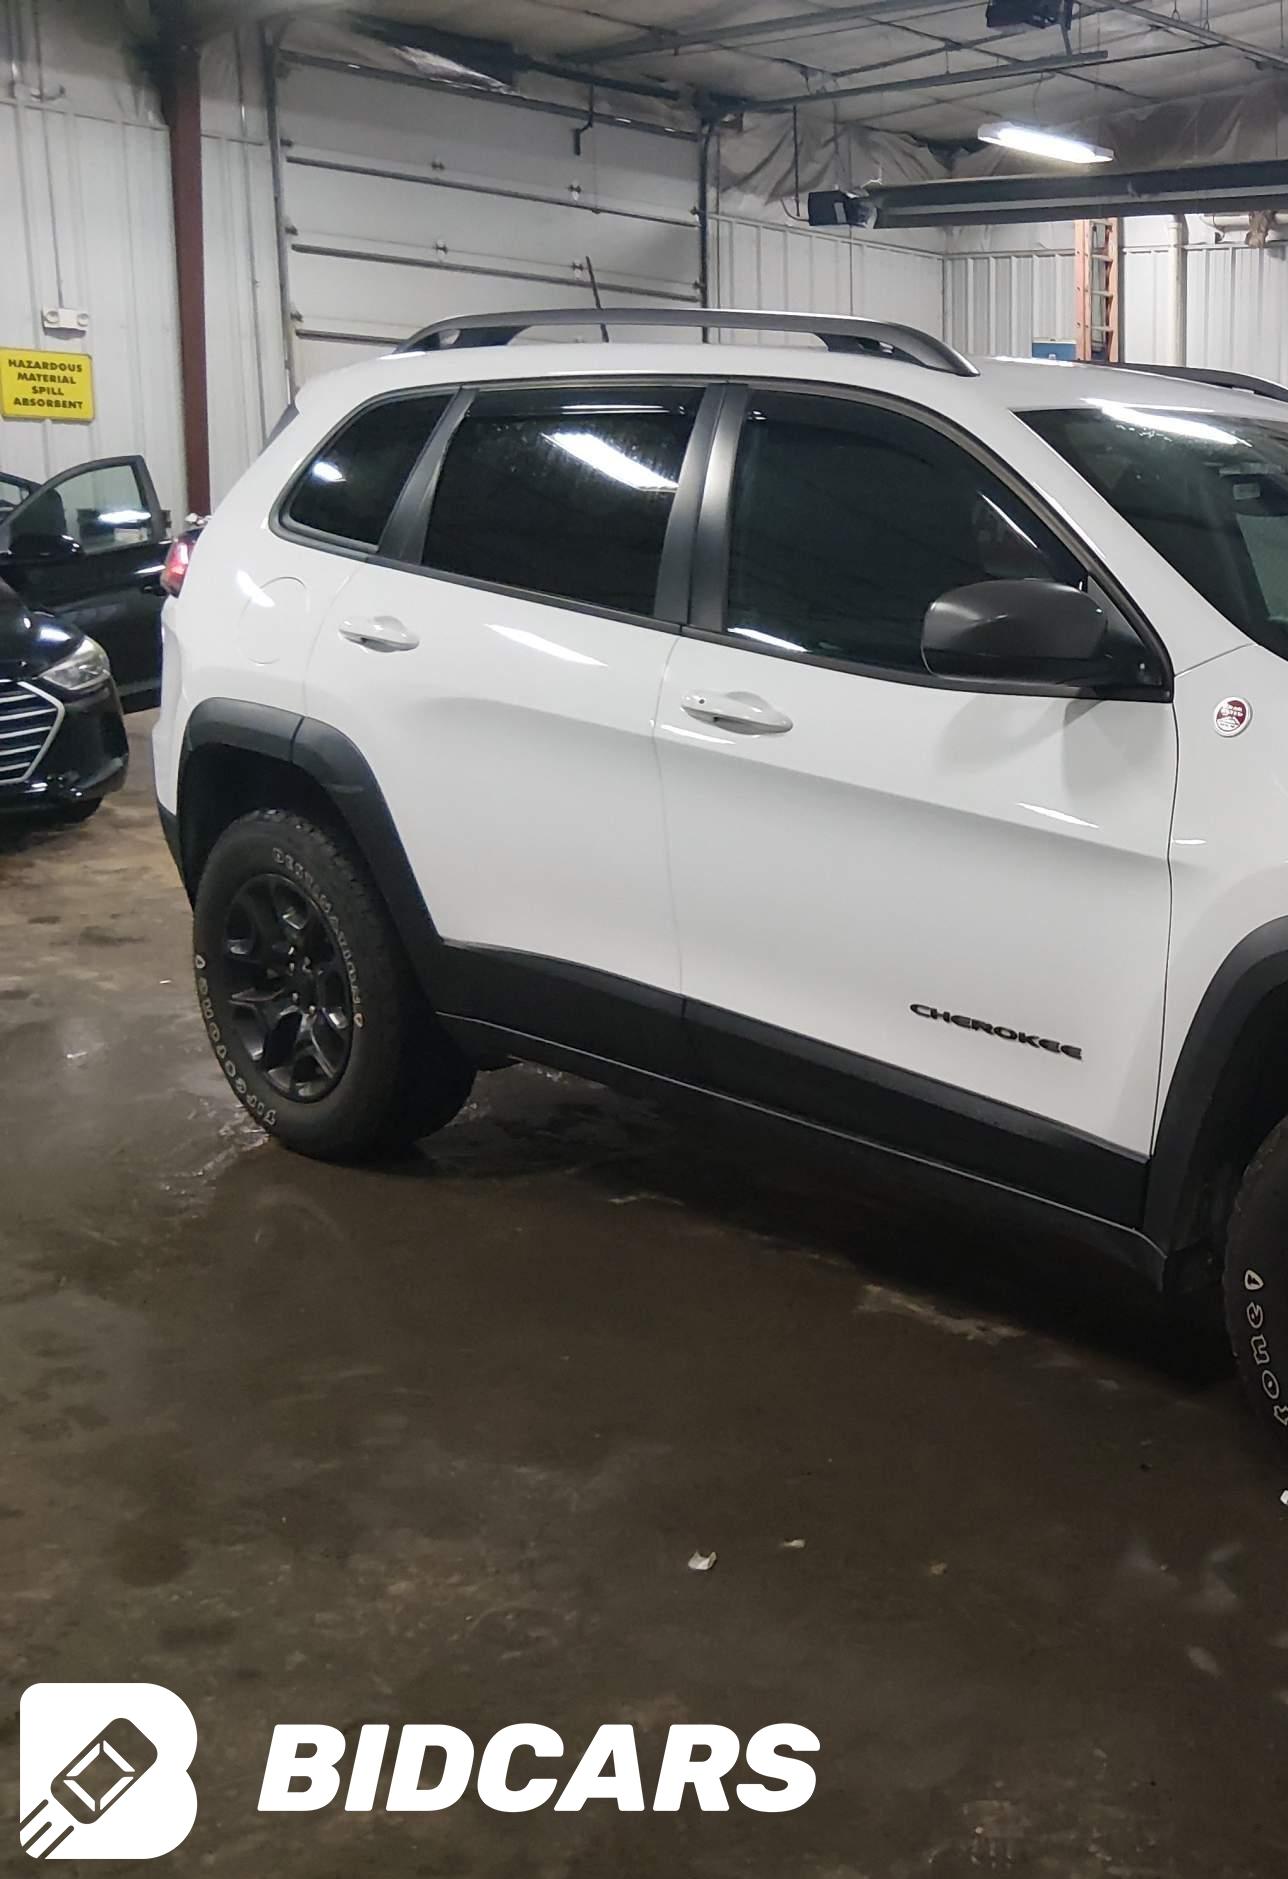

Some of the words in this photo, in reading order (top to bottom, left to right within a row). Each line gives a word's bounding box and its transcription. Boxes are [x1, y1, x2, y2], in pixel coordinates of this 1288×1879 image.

[8, 358, 83, 373] HAZARDOUS
[17, 372, 77, 385] MATERIAL
[31, 385, 65, 397] SPILL
[13, 396, 84, 410] ABSORBENT
[909, 1003, 1083, 1061] CHEROKEE
